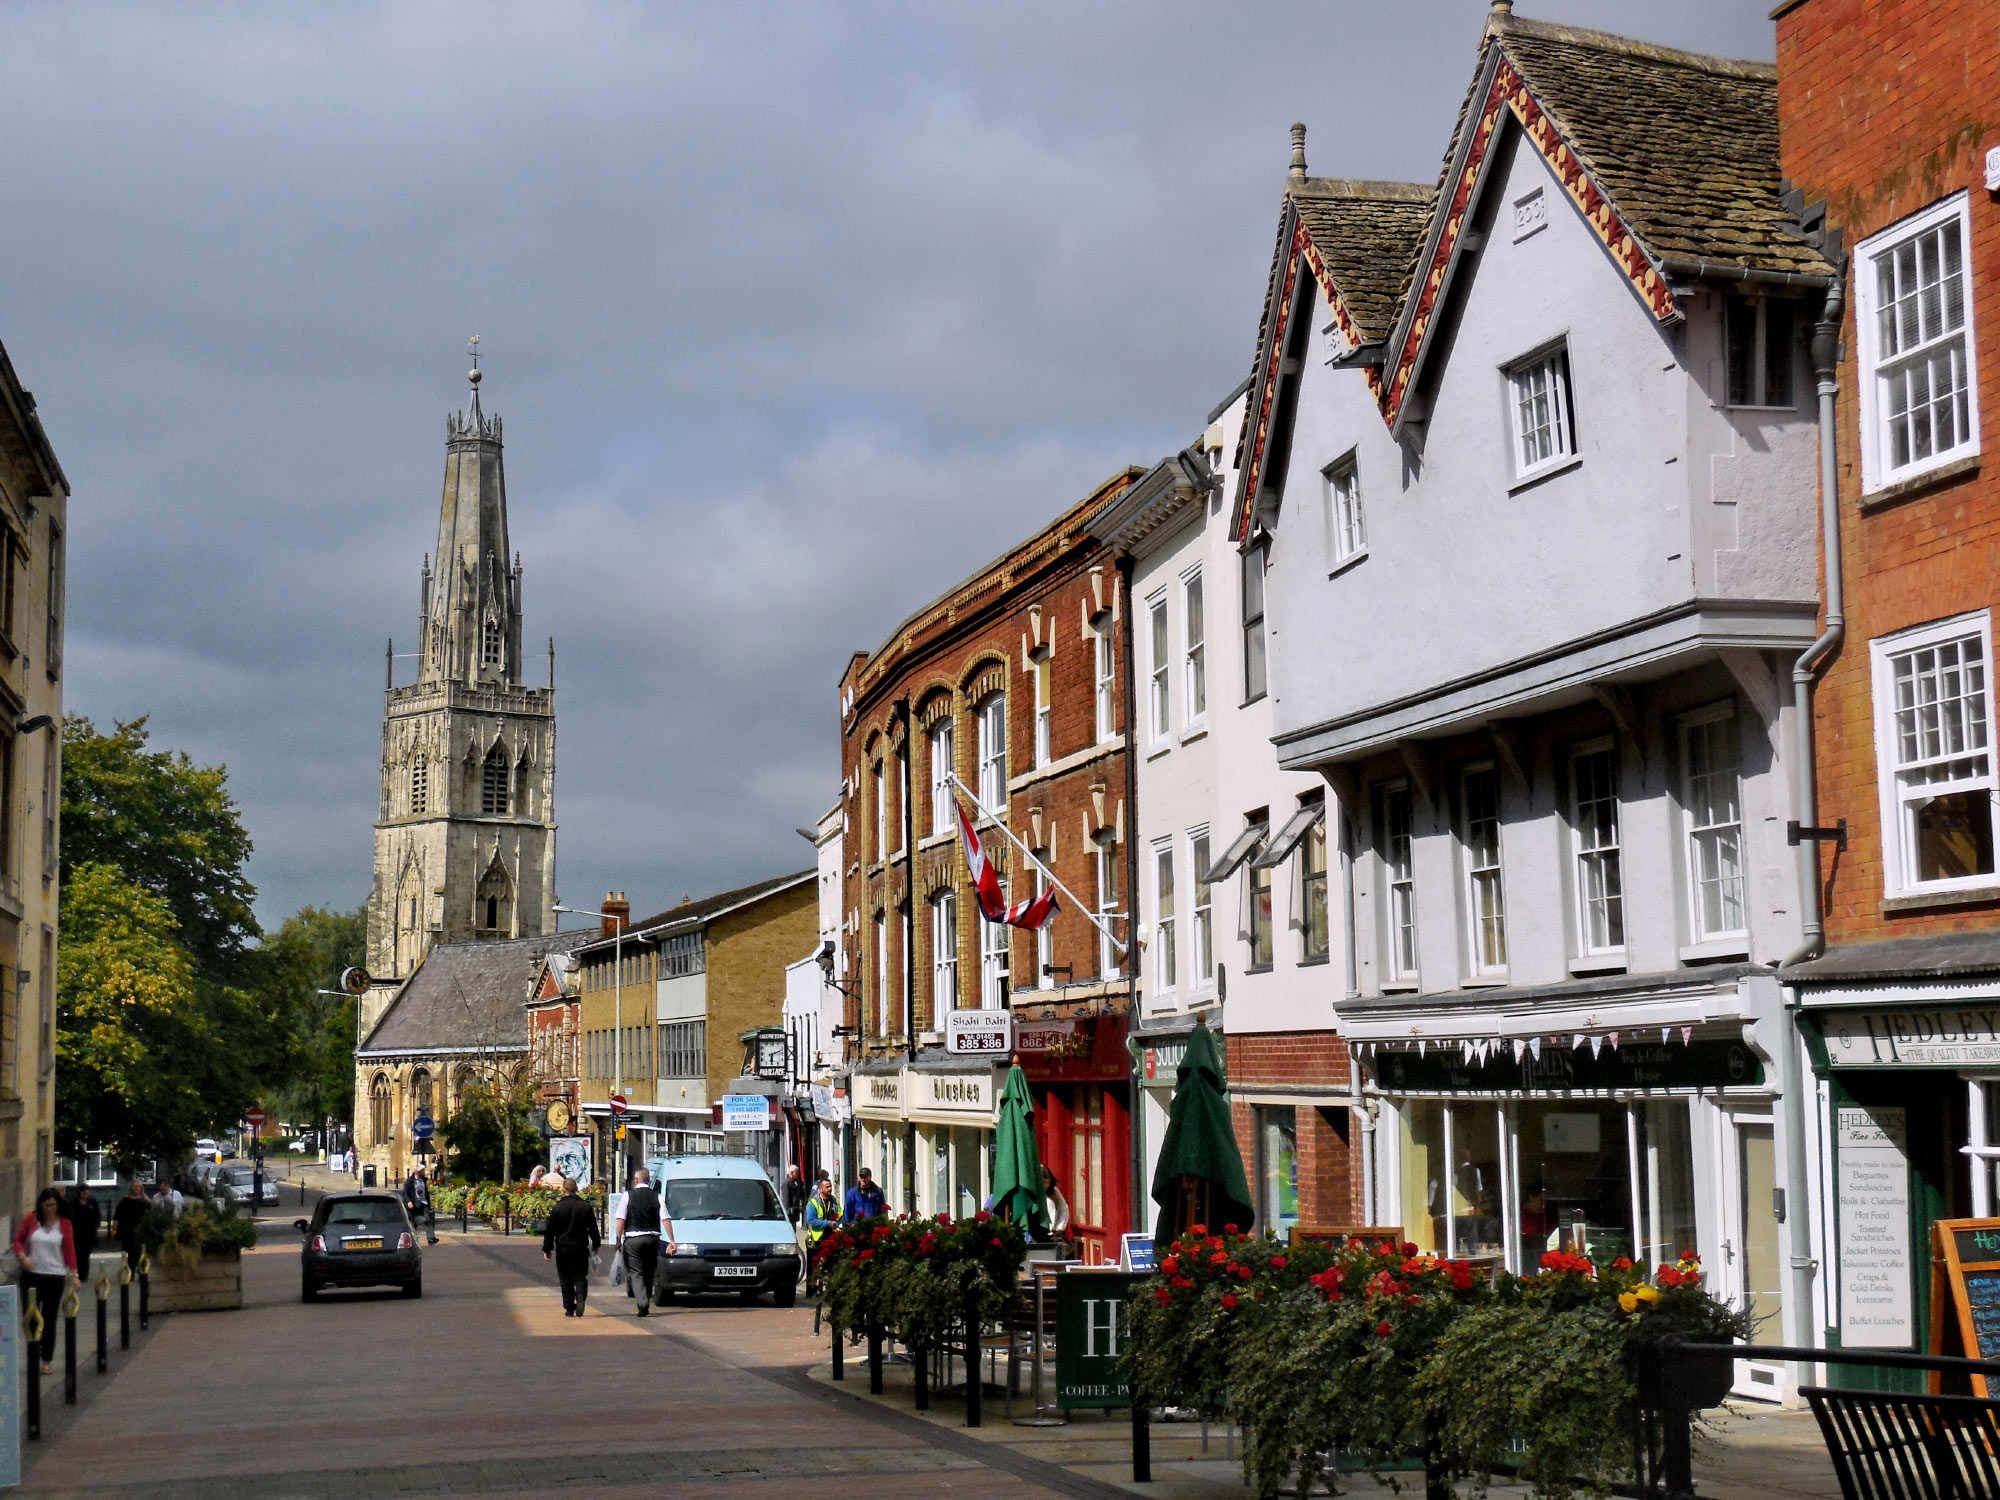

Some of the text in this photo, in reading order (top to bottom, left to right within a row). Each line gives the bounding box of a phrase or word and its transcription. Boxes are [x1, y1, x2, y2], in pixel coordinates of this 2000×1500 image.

[953, 1016, 1006, 1026] Shahi Balti
[959, 1039, 1002, 1049] 385 386
[1927, 1048, 1960, 1062] QUALITY
[1849, 1130, 1869, 1141] Fine
[1853, 1170, 1889, 1181] Baguettes
[1849, 1183, 1893, 1192] Sandwiches
[1840, 1196, 1859, 1205] Rolls
[1871, 1196, 1905, 1206] Ciabattas
[1855, 1211, 1890, 1220] Hot Food
[1858, 1225, 1887, 1233] Toasted
[1851, 1233, 1895, 1242] Sandwiches
[1844, 1246, 1902, 1255] Jacket Potatoes
[1842, 1259, 1905, 1269] Takeaway Coffee
[1856, 1273, 1880, 1282] Crisps
[1849, 1283, 1894, 1292] Cold Drinks
[1849, 1316, 1905, 1325] Buffet Lunches
[1065, 1384, 1110, 1396] COFFEE
